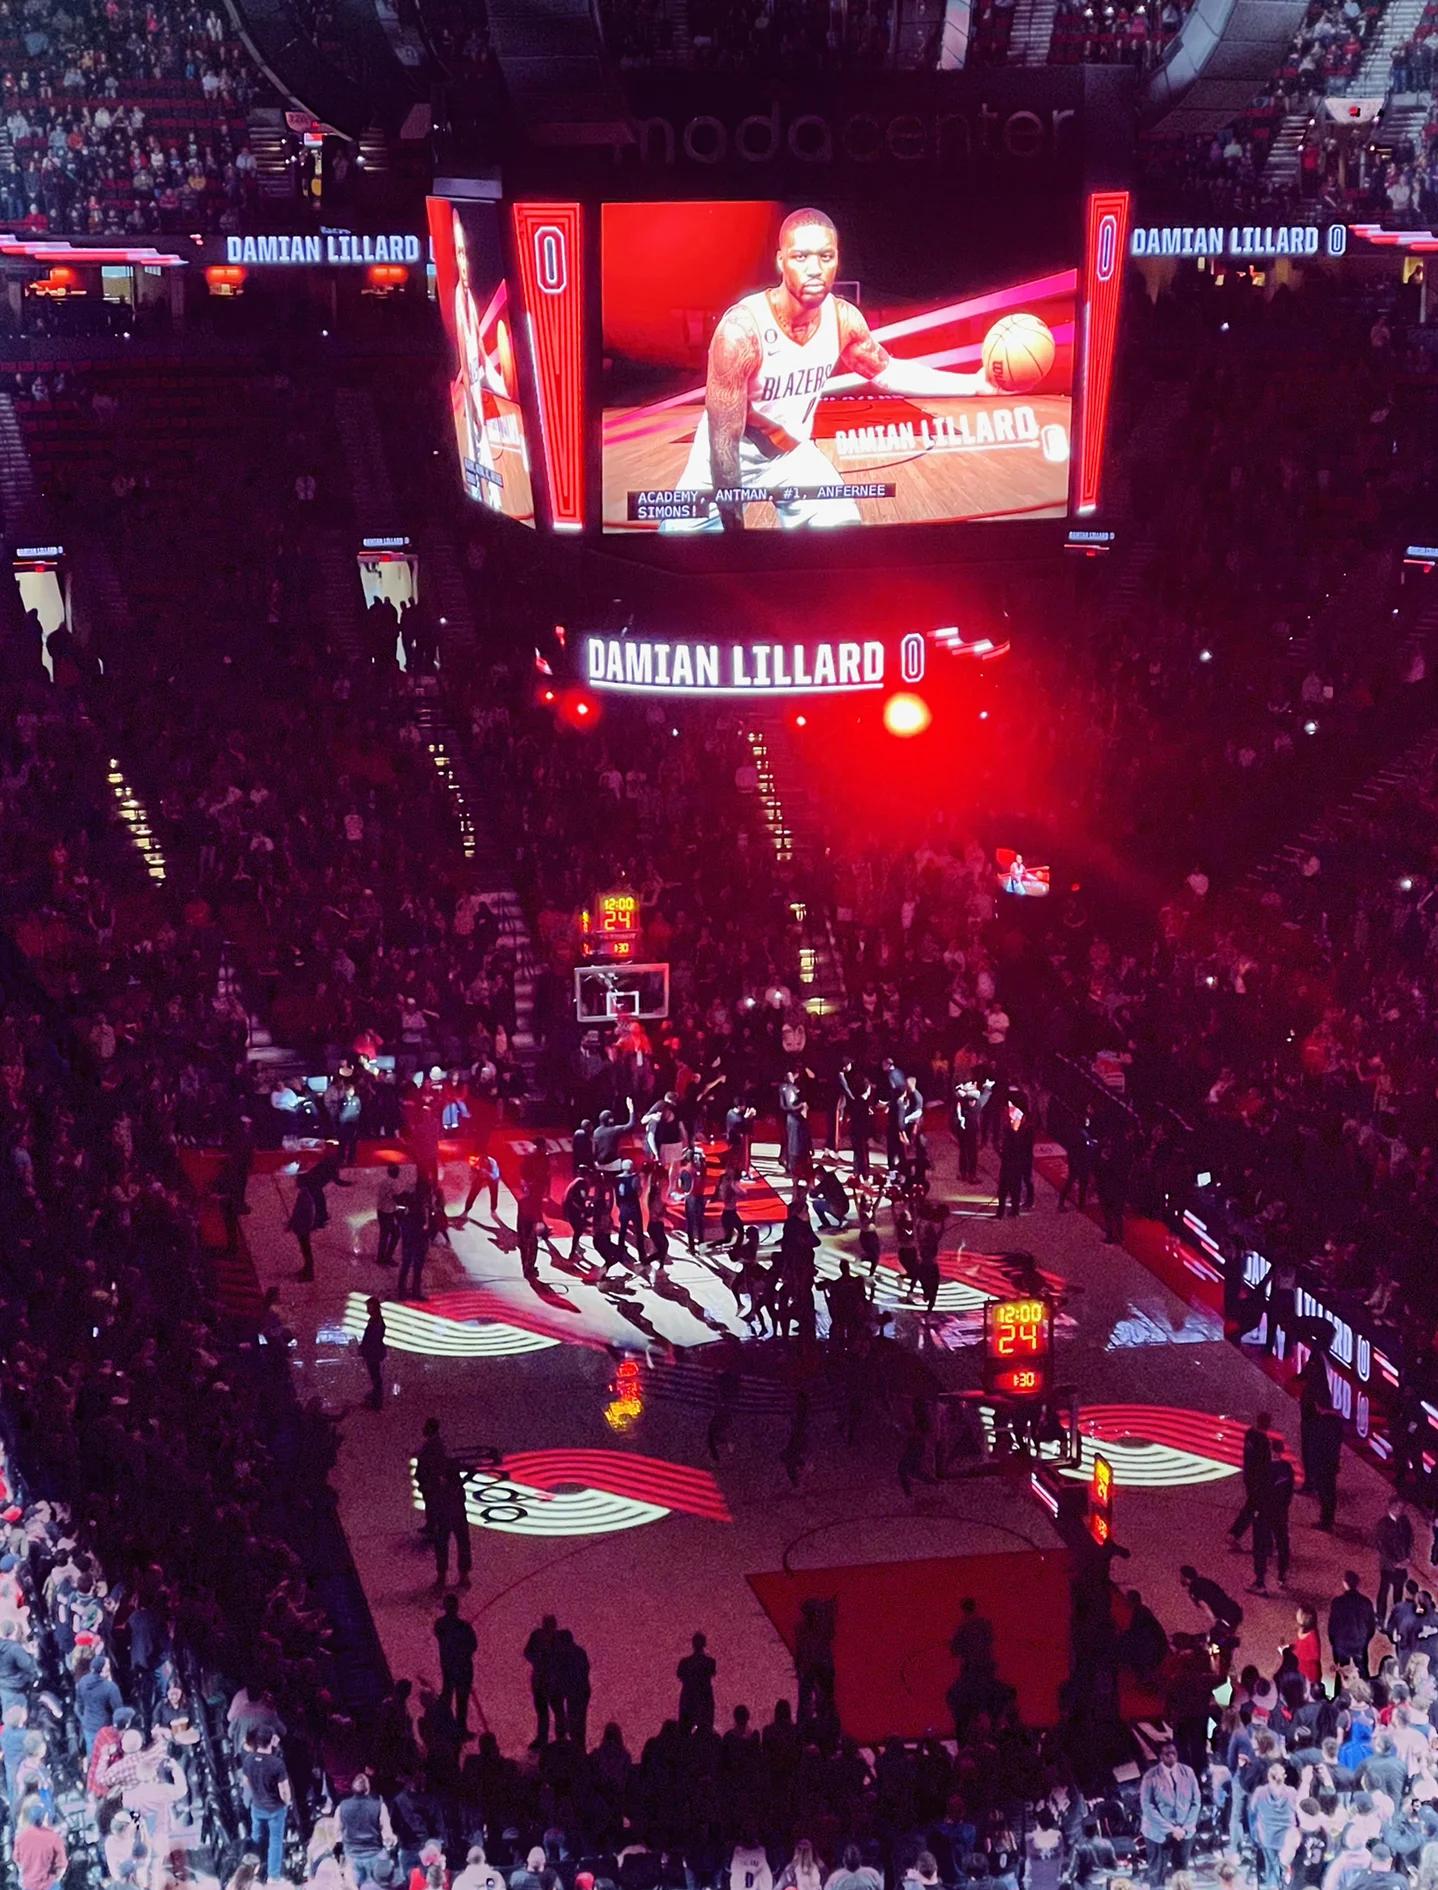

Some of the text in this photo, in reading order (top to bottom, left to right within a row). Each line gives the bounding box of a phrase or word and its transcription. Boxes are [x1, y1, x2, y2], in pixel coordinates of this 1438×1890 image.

[227, 236, 321, 263] DAMIAN
[327, 235, 419, 262] LILLARD
[1096, 215, 1117, 281] 0
[1131, 225, 1346, 256] DAMIAN LILLARD 0
[534, 226, 567, 294] 0
[761, 363, 832, 401] BLAZERS
[835, 421, 917, 454] DAMIAN
[921, 406, 1040, 448] LILLARD
[637, 484, 886, 504] ACADEMY, ANTMAN, #1, ANFERNEE
[637, 505, 697, 519] SIMONS!
[588, 633, 925, 687] DAMIAN LILLARD 0
[604, 896, 635, 910] 12:00
[604, 911, 631, 930] 24
[999, 1303, 1042, 1323] 12:00
[998, 1324, 1037, 1354] 24
[1013, 1372, 1035, 1387] 1:30
